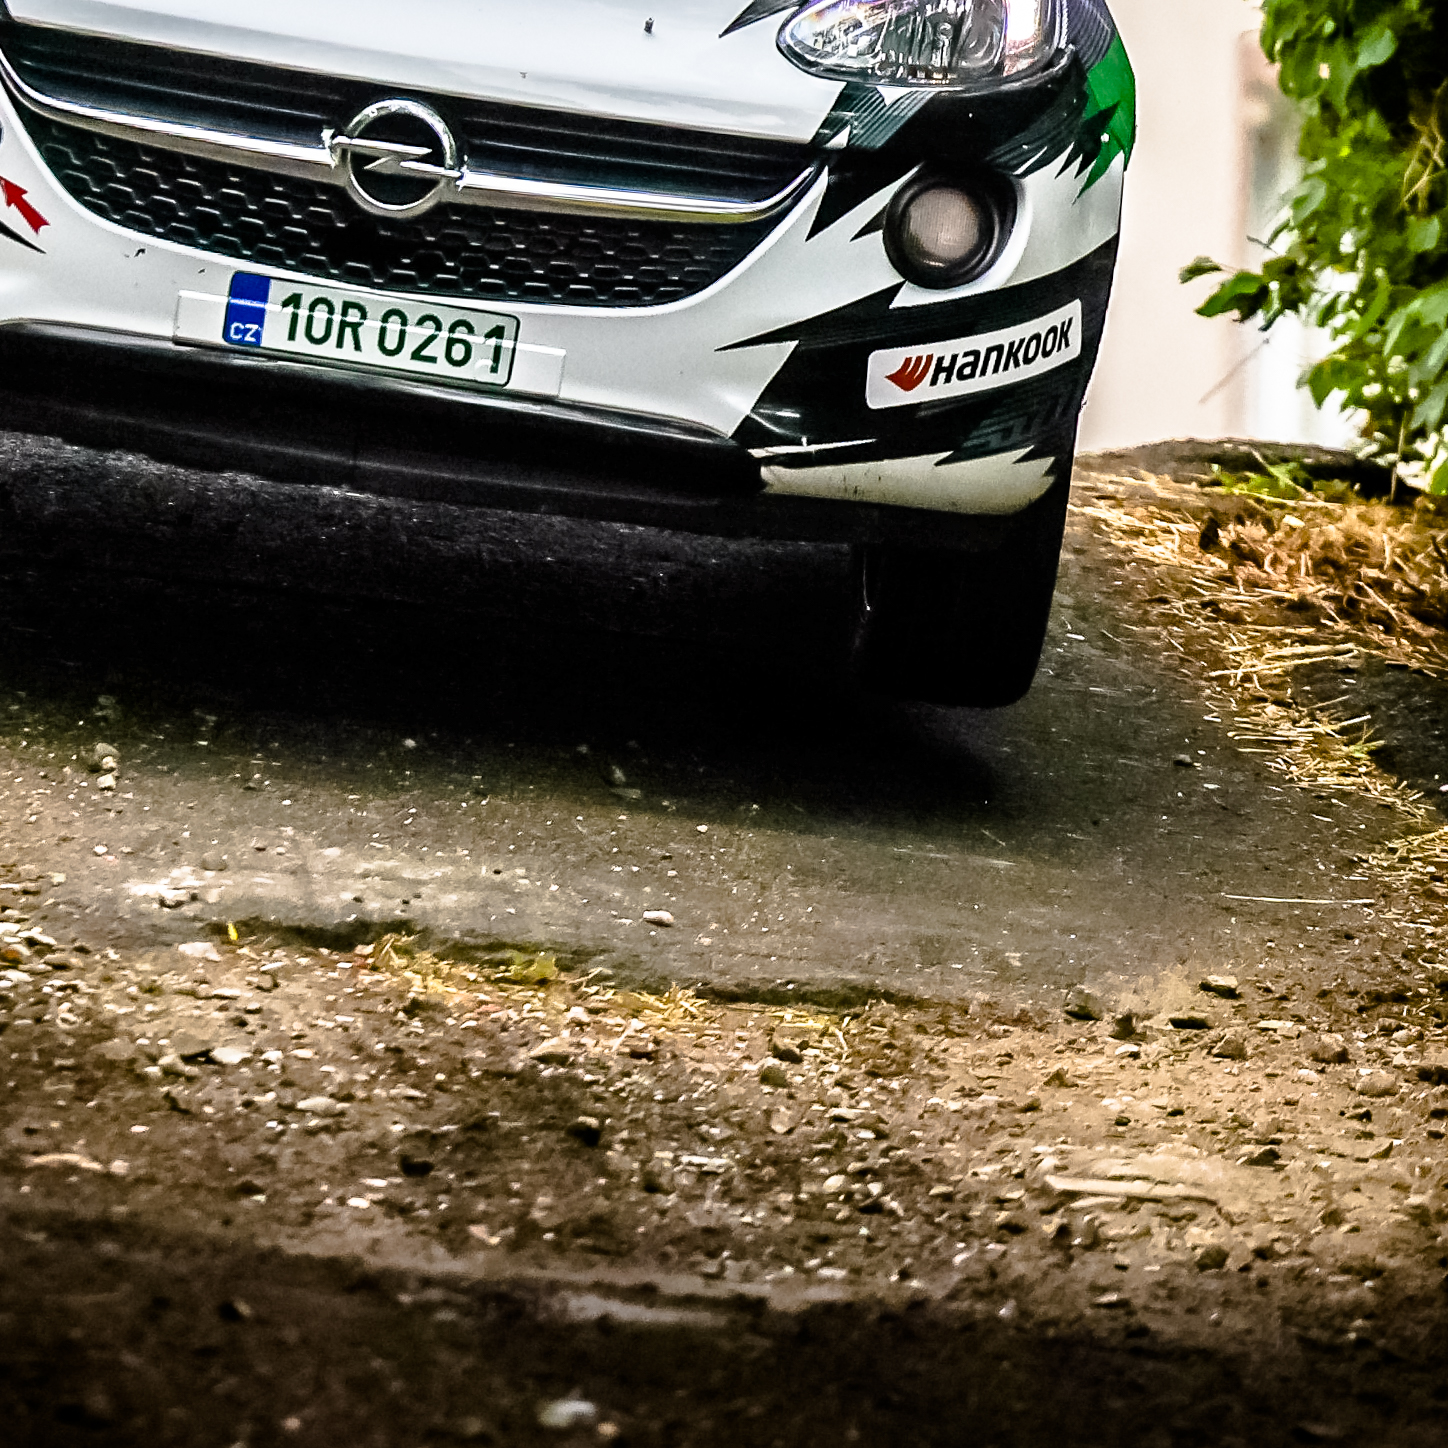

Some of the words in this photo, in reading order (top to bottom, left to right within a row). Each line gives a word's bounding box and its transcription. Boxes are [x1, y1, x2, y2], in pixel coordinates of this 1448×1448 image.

[229, 324, 260, 342] CZ
[281, 292, 368, 352] 10R
[377, 308, 507, 374] 0261
